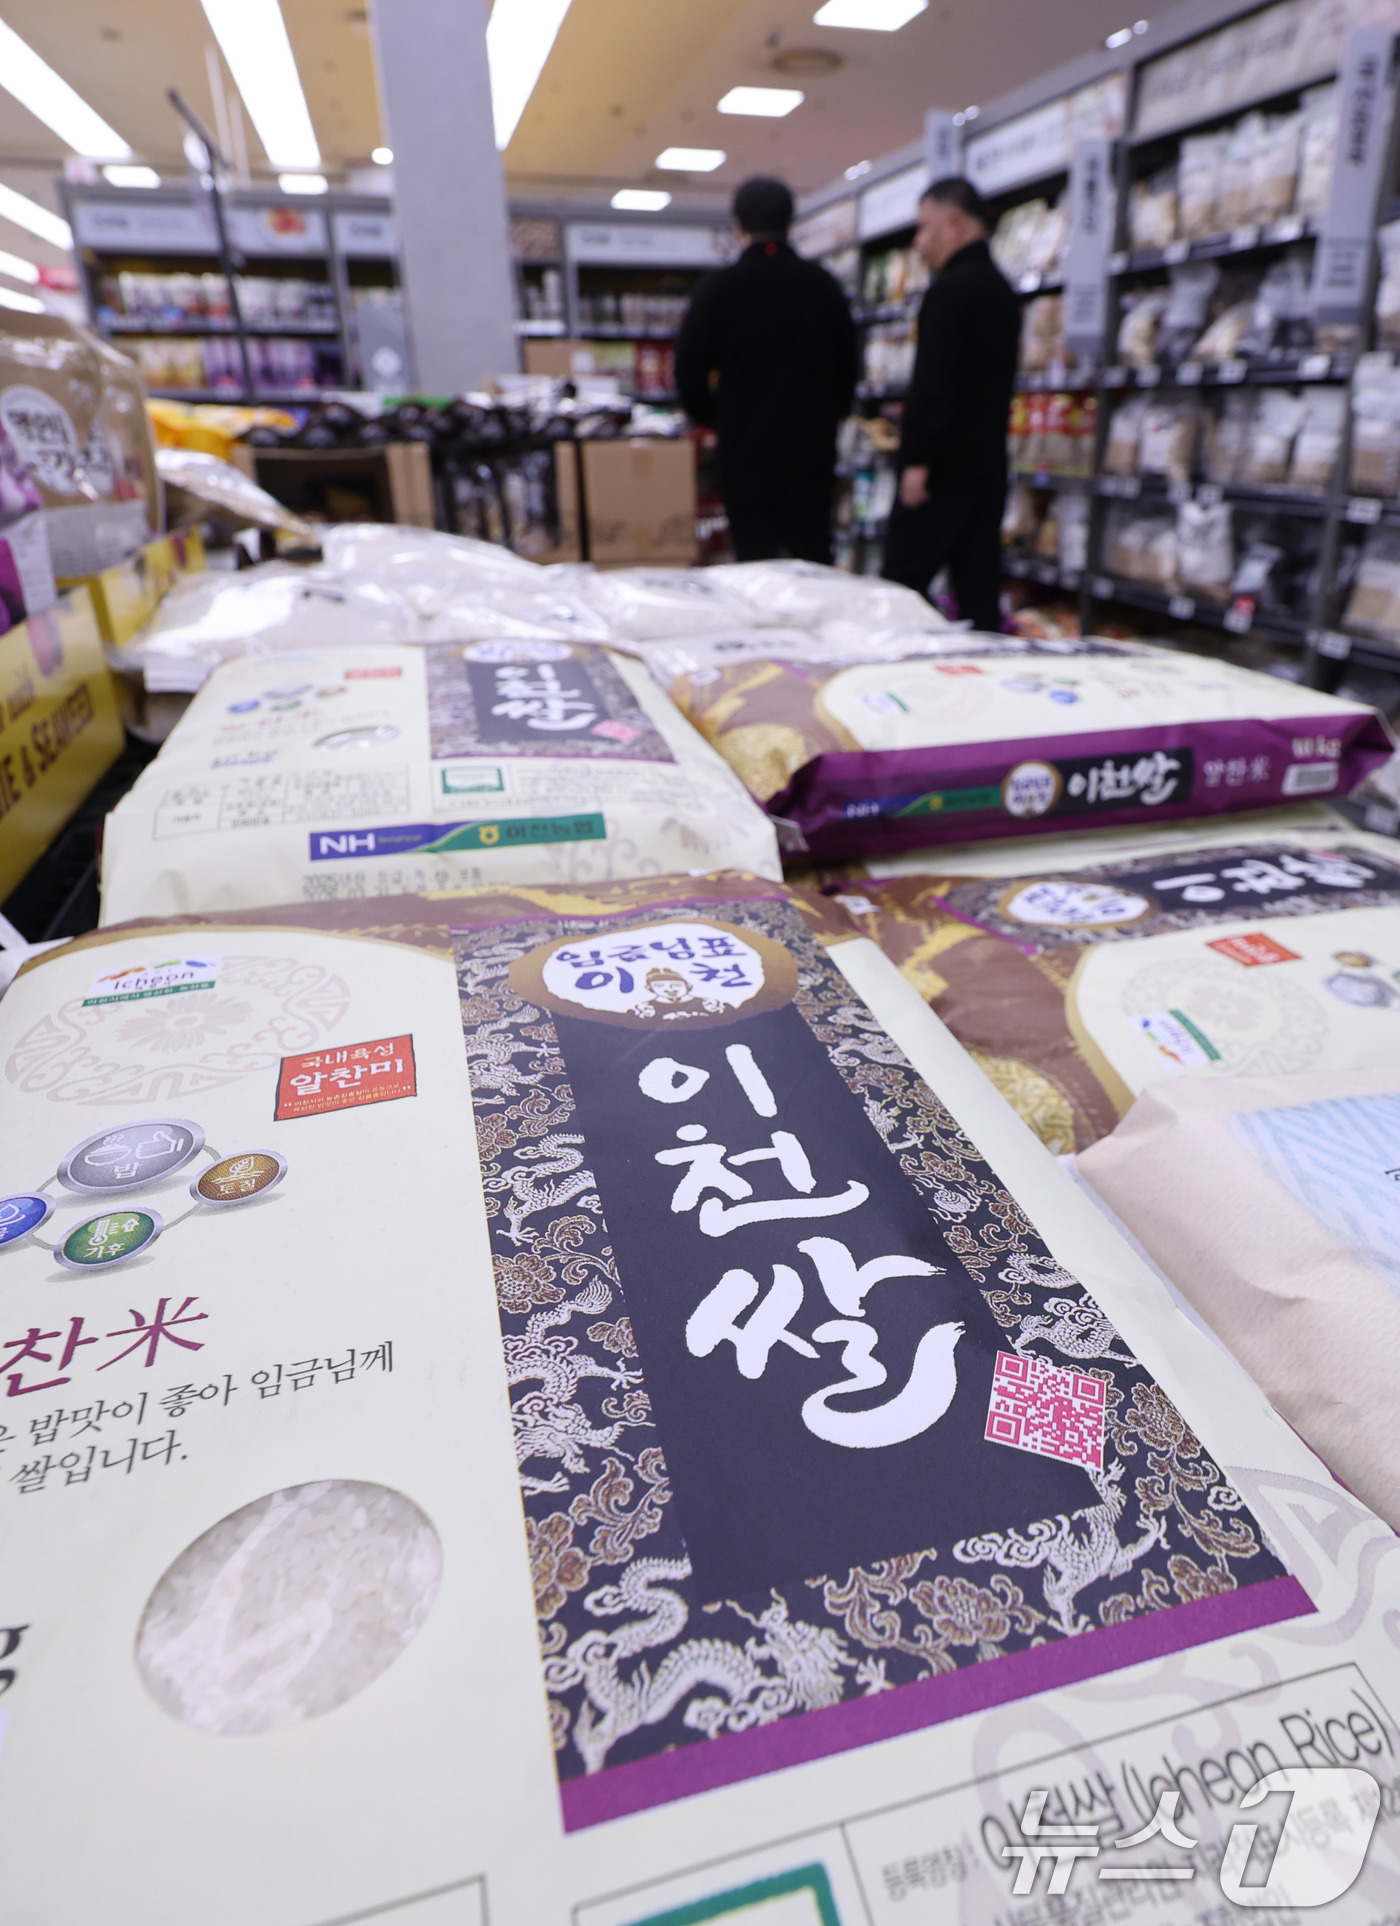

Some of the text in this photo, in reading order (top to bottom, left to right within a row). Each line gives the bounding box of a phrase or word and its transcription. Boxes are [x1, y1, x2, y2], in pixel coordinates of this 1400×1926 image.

[1067, 751, 1181, 805] 이천쌀
[319, 833, 375, 855] NH
[1153, 854, 1377, 902] 이천쌀
[556, 937, 747, 968] 임금님표
[301, 1042, 395, 1068] 국내육성
[289, 1058, 404, 1096] 알찬미
[112, 1162, 142, 1180] 밥
[84, 1241, 125, 1259] 기후
[638, 1043, 967, 1449] 이천쌀
[28, 1391, 150, 1447] 밥맛이
[158, 1373, 239, 1419] 좋아
[250, 1340, 394, 1400] 임금님께
[8, 1429, 188, 1495] 쌀입니다.
[1278, 1687, 1394, 1774] Rice)
